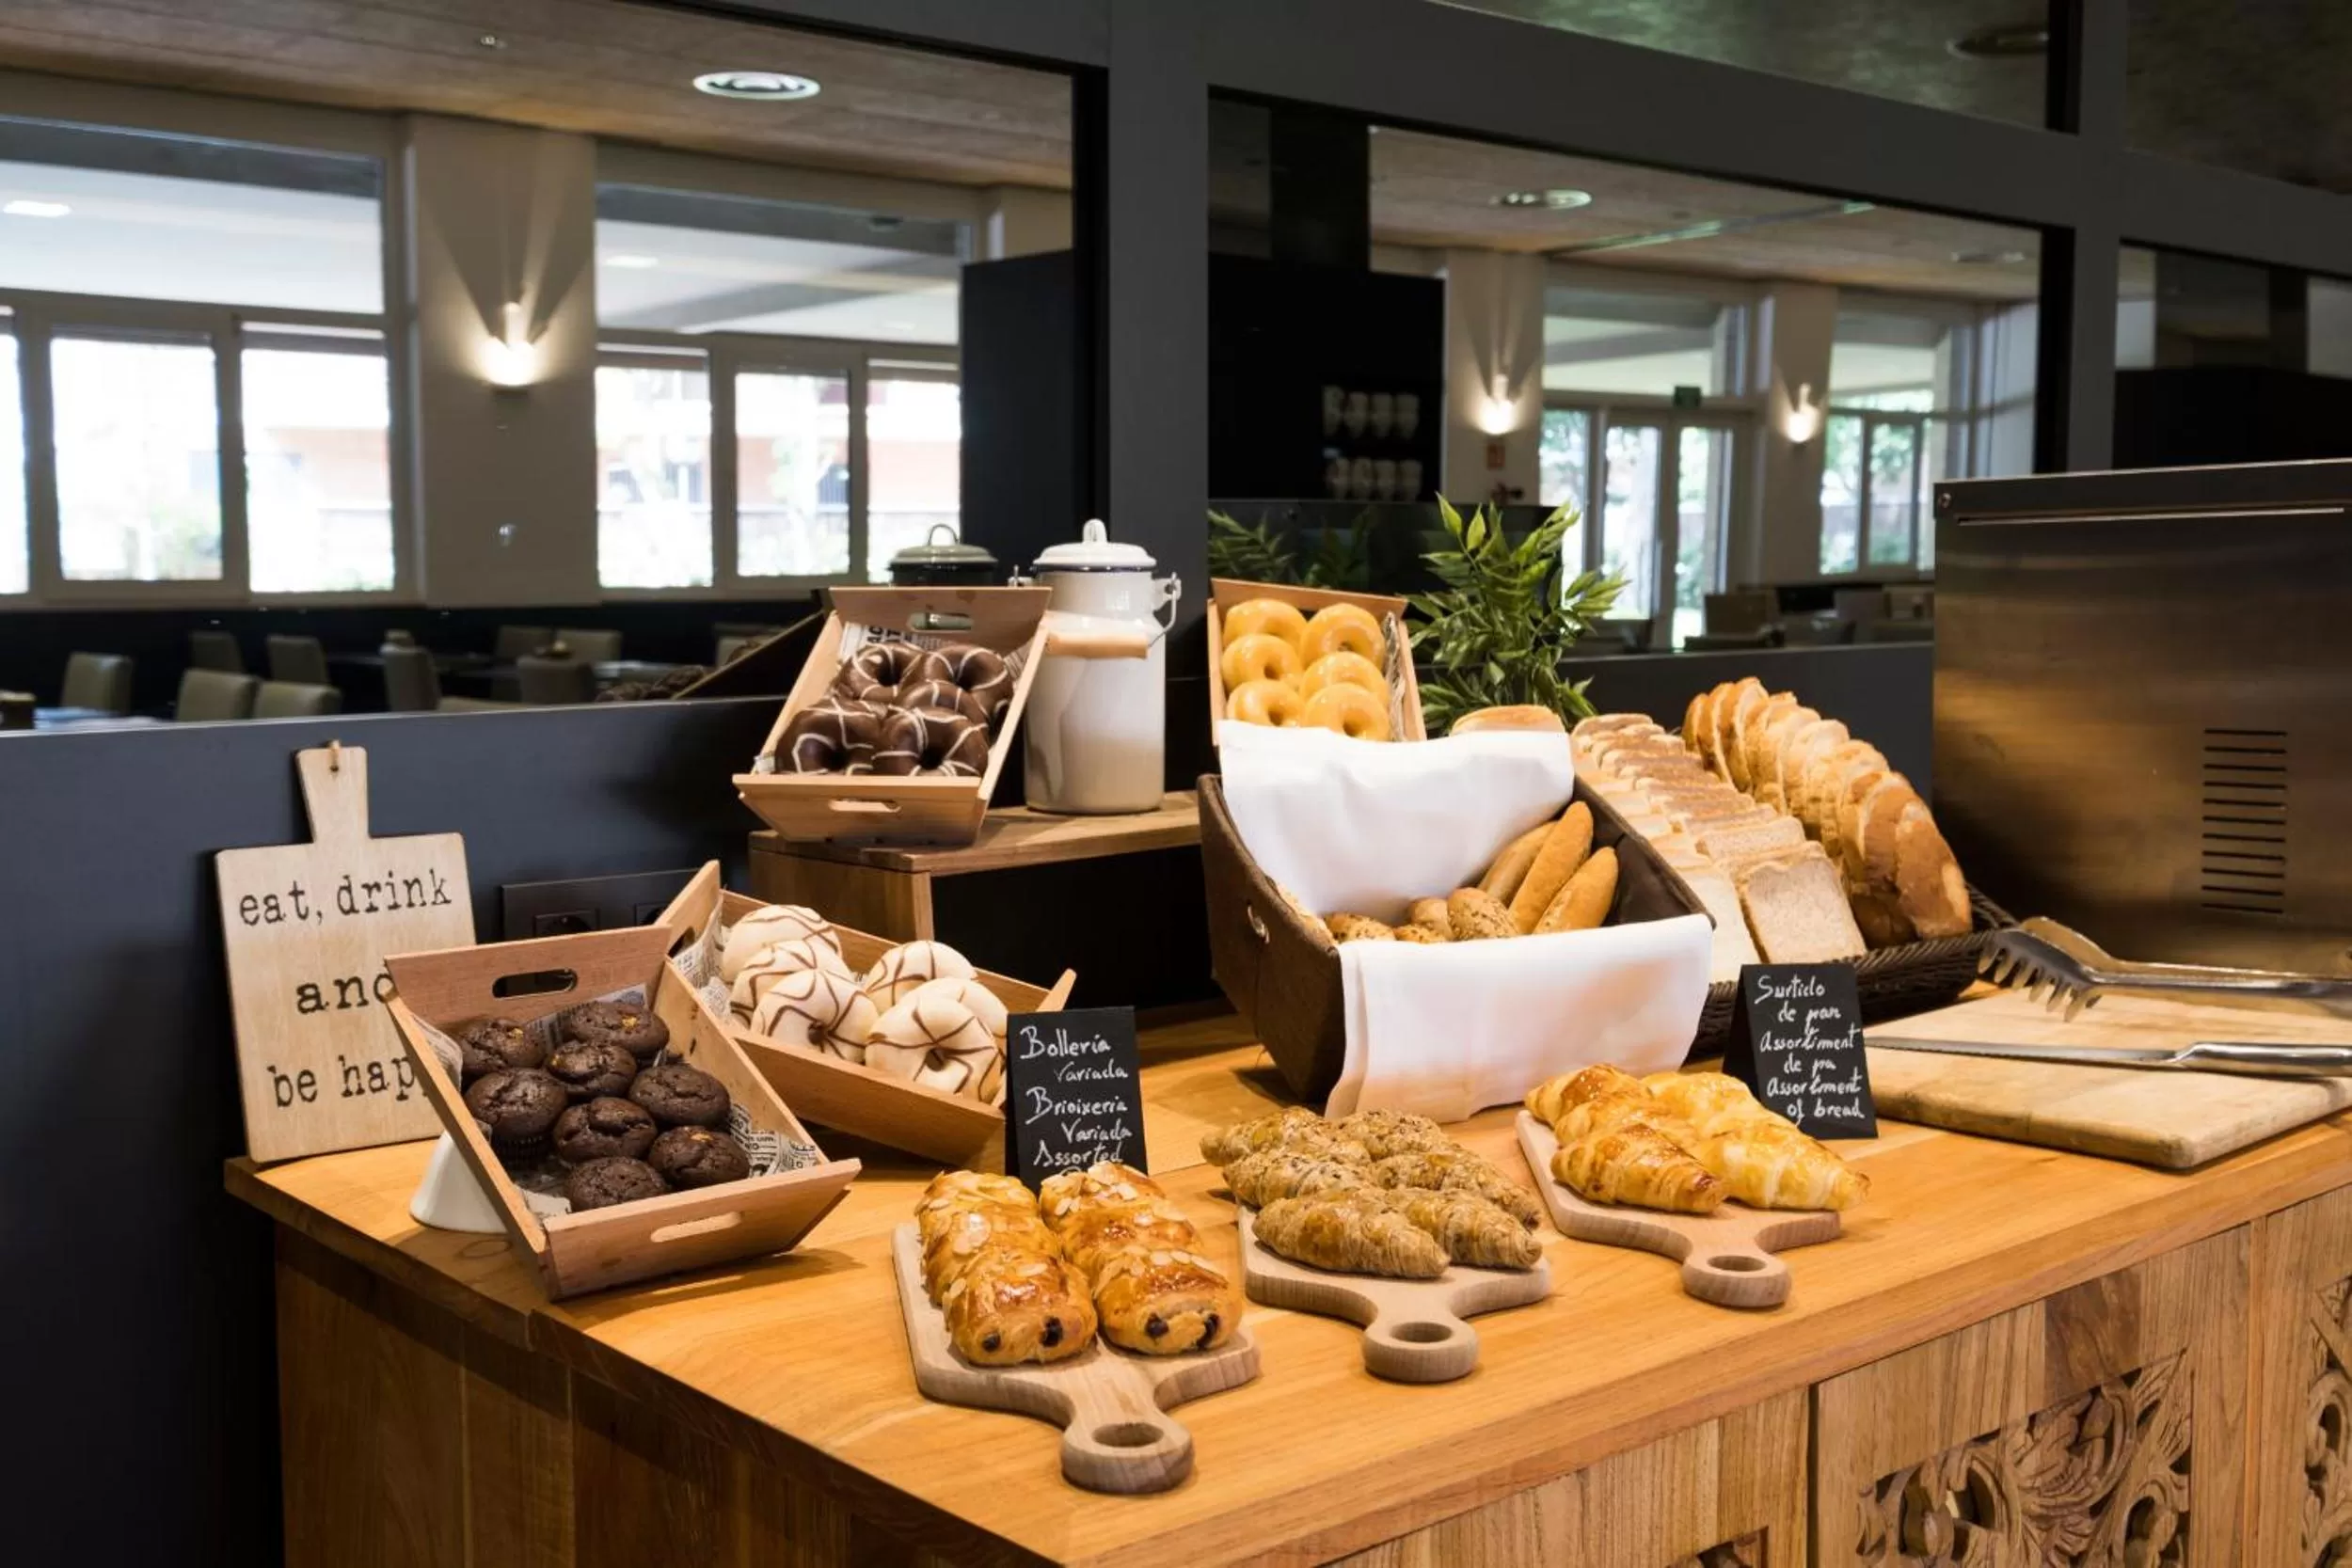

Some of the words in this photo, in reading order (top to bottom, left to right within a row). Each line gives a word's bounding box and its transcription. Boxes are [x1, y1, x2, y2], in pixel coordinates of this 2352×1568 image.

[239, 880, 323, 926] eat,
[336, 868, 452, 916] drink
[1754, 974, 1825, 1005] Surtido
[1777, 1000, 1797, 1022] de
[1804, 1006, 1841, 1036] pan
[1054, 1058, 1129, 1083] Variada
[1783, 1052, 1802, 1074] de
[1812, 1058, 1836, 1079] pa
[267, 1065, 318, 1108] be
[338, 1054, 430, 1101] hap
[1787, 1098, 1805, 1127] of
[1814, 1097, 1866, 1118] bread
[1060, 1117, 1133, 1144] Variada
[1033, 1139, 1123, 1167] Assorted
